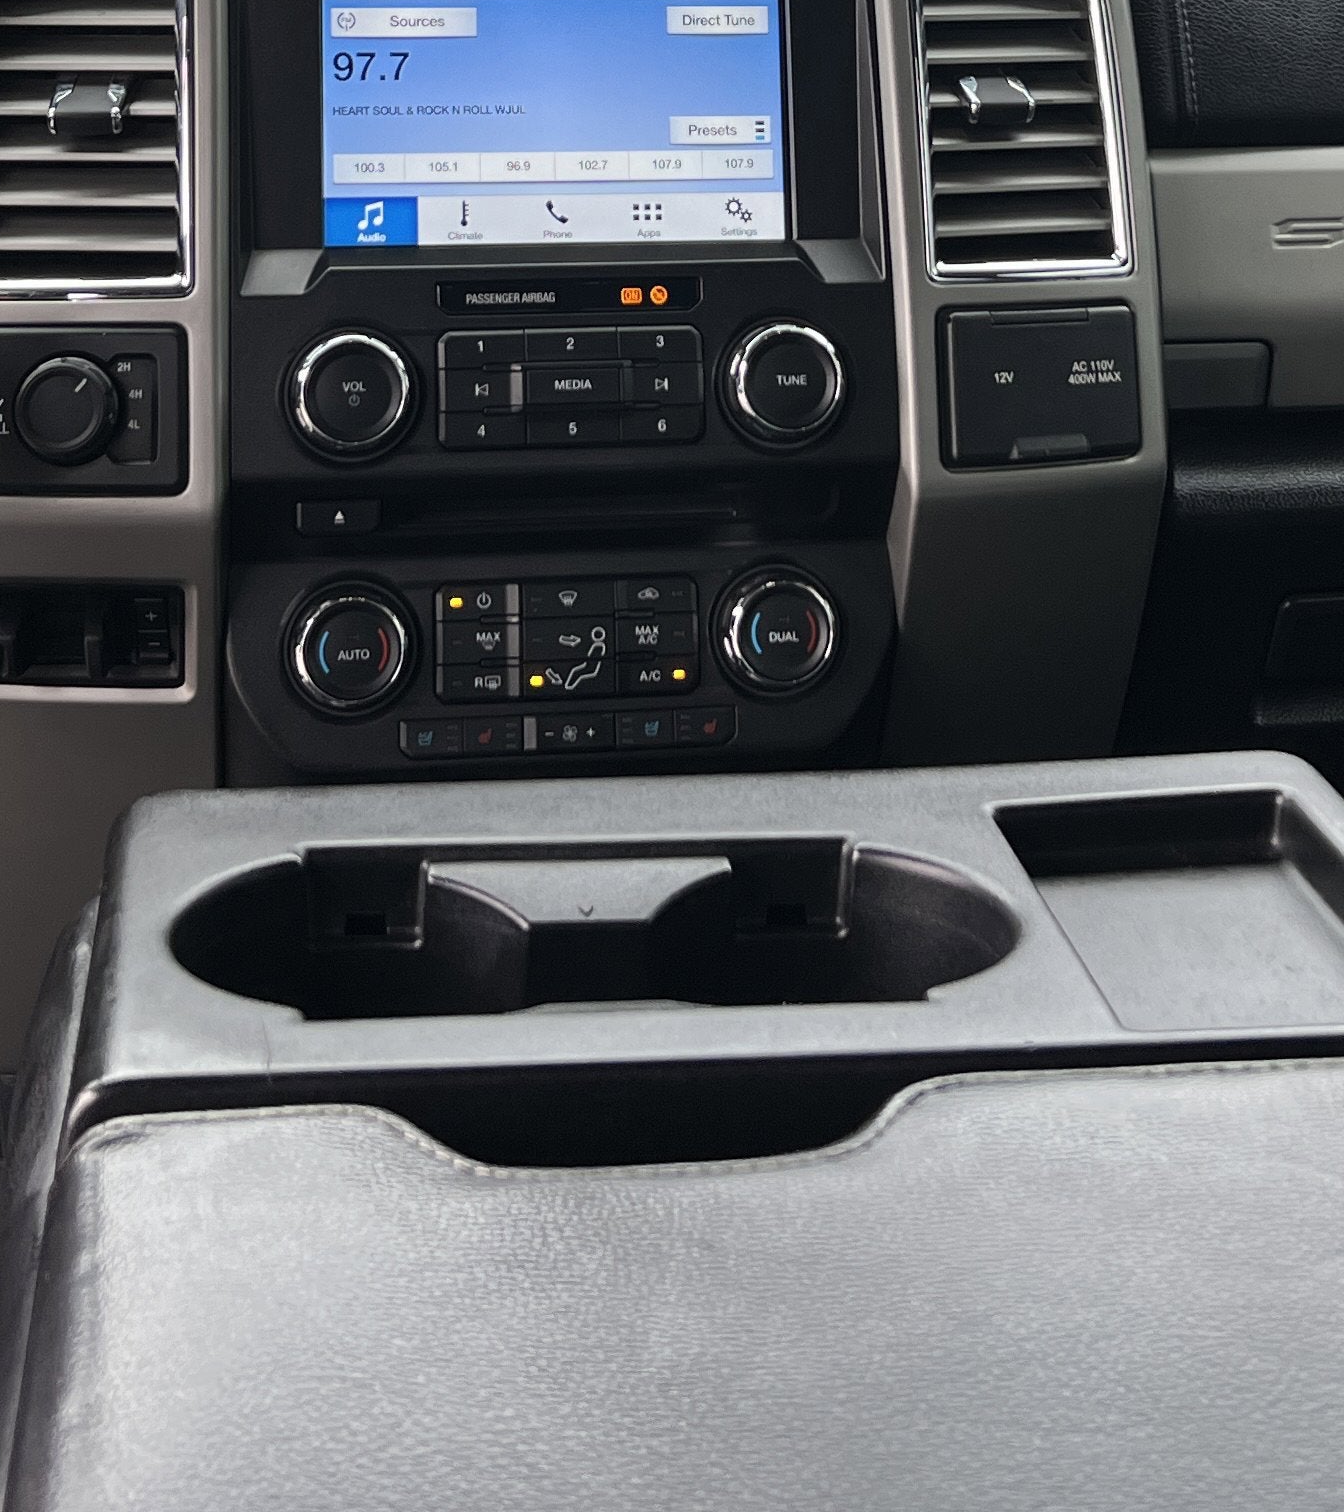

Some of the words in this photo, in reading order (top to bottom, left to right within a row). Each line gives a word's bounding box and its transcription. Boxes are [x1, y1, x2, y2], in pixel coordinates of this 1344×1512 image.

[389, 14, 446, 28] Sources
[682, 14, 721, 26] Direct
[724, 14, 756, 26] Tune
[332, 51, 410, 82] 97.7
[332, 105, 370, 116] HEART
[372, 105, 404, 116] SOUL
[406, 105, 414, 116] &
[416, 105, 450, 116] ROCK
[452, 105, 461, 115] N
[463, 105, 493, 115] ROLL
[687, 123, 738, 137] Presets
[353, 162, 385, 173] 100.3
[429, 161, 458, 172] 105.1
[506, 160, 531, 171] 96.9
[578, 159, 609, 170] 102.7
[652, 158, 682, 169] 107.9
[724, 157, 754, 169] 107.9
[357, 232, 387, 243] Audio
[447, 230, 484, 241] Climate
[542, 229, 573, 239] Phone
[636, 228, 661, 239] Apps
[720, 226, 758, 238] Settings
[465, 292, 520, 305] PASSENGER
[521, 291, 556, 304] AIRBAG
[477, 340, 484, 353] 1
[565, 336, 575, 351] 2
[656, 334, 665, 348] 3
[117, 361, 131, 373] 2H
[1071, 360, 1087, 373] AC
[1089, 359, 1115, 372] 110V
[775, 373, 808, 387] TUNE
[993, 371, 1014, 383] 12V
[1067, 372, 1097, 385] 400W
[1098, 371, 1122, 384] MAX
[341, 380, 366, 393] VOL
[554, 378, 593, 391] MEDIA
[128, 388, 143, 400] 4H
[127, 418, 140, 430] 4L
[568, 421, 578, 436] 5
[657, 419, 667, 433] 6
[476, 424, 486, 438] 4
[476, 631, 501, 642] MAX
[635, 625, 659, 636] MAX
[638, 634, 659, 645] A/C
[768, 630, 799, 644] DUAL
[337, 648, 371, 662] AUTO
[639, 669, 661, 683] A/C
